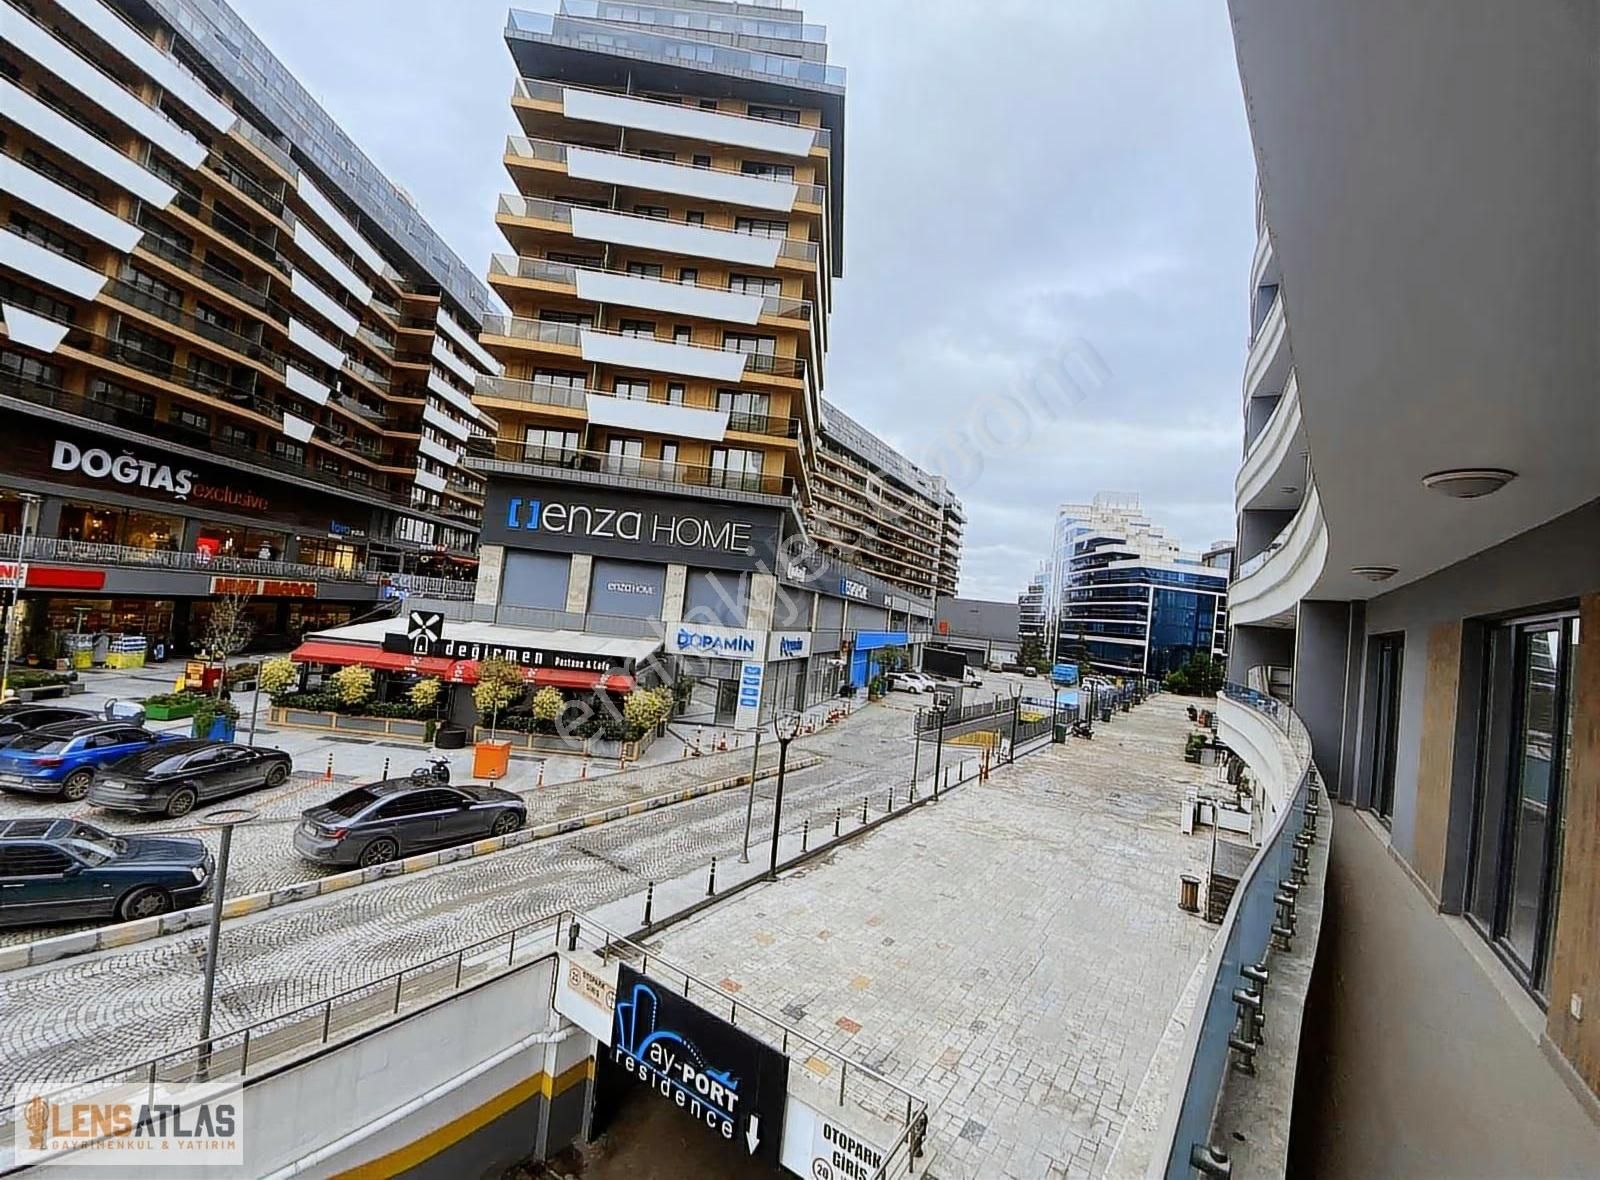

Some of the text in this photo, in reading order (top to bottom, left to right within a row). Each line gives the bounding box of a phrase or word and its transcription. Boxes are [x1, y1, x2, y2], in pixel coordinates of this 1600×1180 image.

[52, 440, 269, 511] DOĞTAŞ exclusive
[542, 502, 752, 552] enza HOME
[615, 1049, 733, 1139] residence
[823, 1123, 882, 1169] OTOPARK
